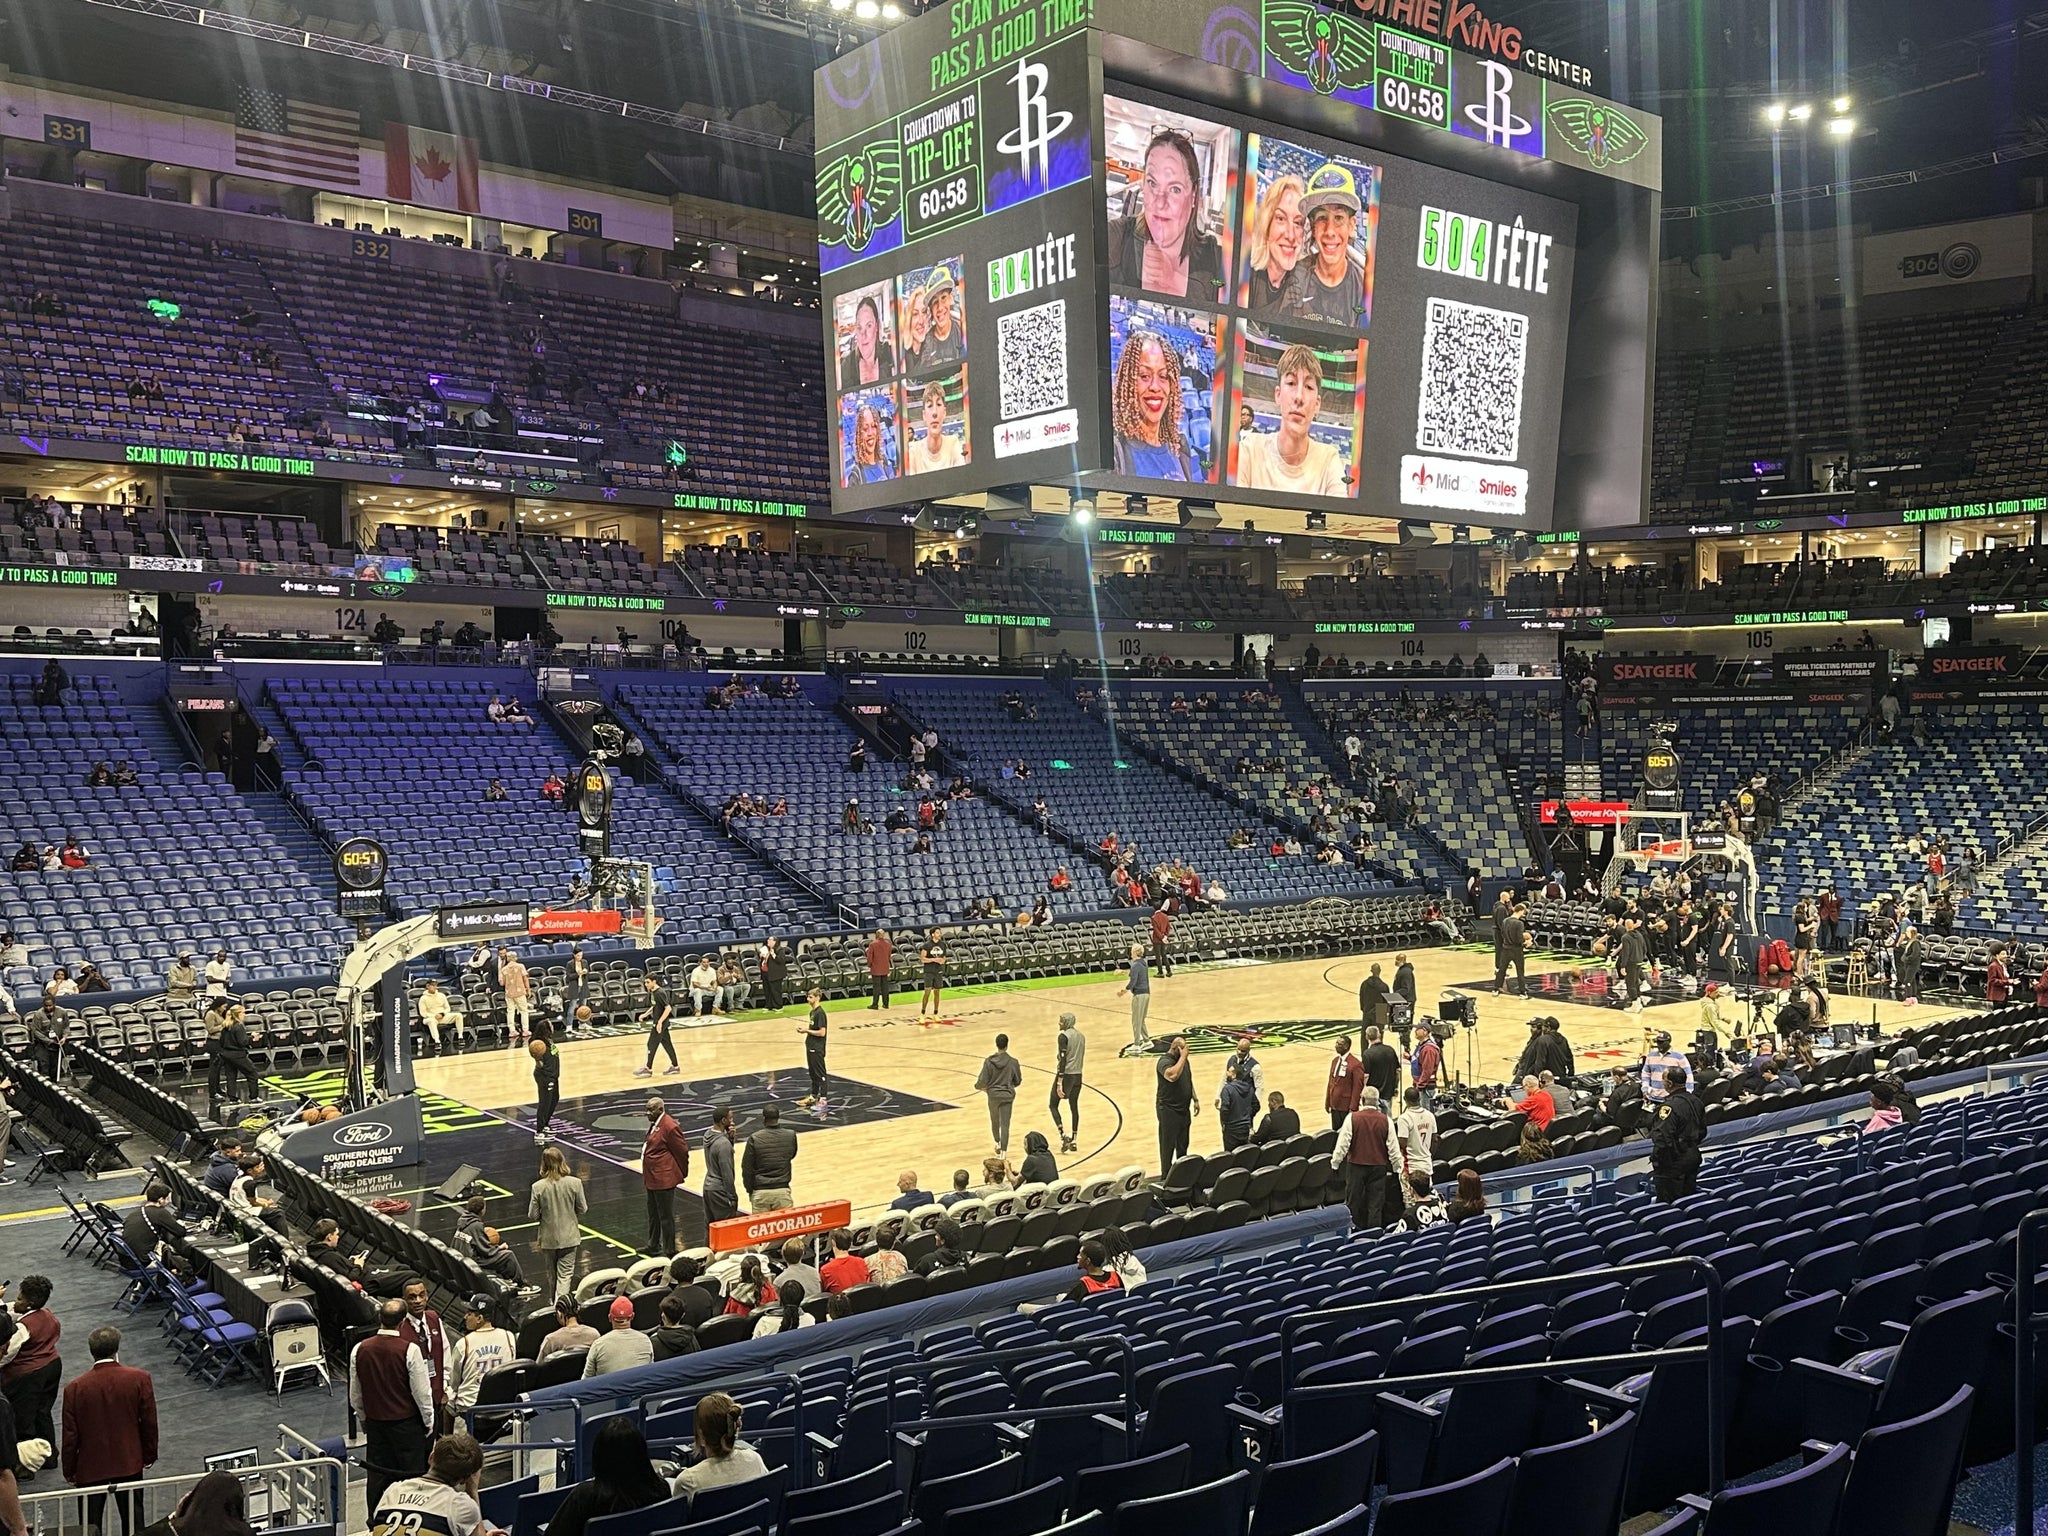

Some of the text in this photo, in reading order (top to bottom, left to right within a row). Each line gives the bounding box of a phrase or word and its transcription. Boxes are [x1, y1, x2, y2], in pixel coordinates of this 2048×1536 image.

[931, 41, 970, 91] PASS
[975, 33, 986, 70] A
[991, 8, 1036, 62] GOOD
[1381, 30, 1444, 65] COUNTDOWN TO
[1390, 50, 1435, 85] TIP-OFF
[1525, 49, 1592, 87] CENTER
[1383, 78, 1444, 121] 60:58
[904, 95, 975, 145] COUNTDOWN TO
[49, 121, 86, 143] 331
[907, 121, 974, 185] TIP-OFF
[919, 178, 967, 219] 60:58
[571, 213, 599, 232] 301
[354, 239, 390, 259] 332
[1422, 209, 1552, 295] 504 FÊTE
[990, 232, 1076, 300] 504 FÊTE
[1905, 257, 1938, 274] 306
[578, 421, 592, 430] 301
[1043, 422, 1070, 436] Smiles
[127, 446, 315, 475] SCAN NOW TO PASS A GOOD TIME!
[1480, 478, 1517, 497] Smiles
[674, 494, 807, 518] SCAN NOW TO PASS A GOOD TIME!
[1903, 497, 2047, 522] SCAN NOW TO PASS A GOOD TIME!
[1099, 529, 1175, 544] TO PASS A GOOD TIME!
[7, 568, 21, 582] TO
[23, 568, 49, 583] PASS
[51, 569, 59, 583] A
[61, 570, 88, 584] GOOD
[90, 571, 117, 586] TIME!
[546, 594, 665, 610] SCAN NOW TO PASS A GOOD TIME!
[334, 607, 367, 631] 124
[964, 613, 1051, 627] SCAN NOW TO PASS A GOOD TIME!
[1734, 610, 1849, 624] SCAN NOW TO PASS A GOOD TIME!
[1315, 623, 1415, 632] SCAN NOW TO PASS A GOOD TIME!
[904, 631, 926, 650] 102
[1118, 638, 1141, 656] 103
[1400, 639, 1425, 657] 104
[1746, 630, 1773, 648] 105
[1613, 662, 1697, 681] SEATGEEK
[1932, 655, 2007, 674] SEATGEEK
[1808, 694, 1845, 702] SEATGEEK
[343, 851, 379, 866] 60:57
[353, 889, 383, 898] TISSOT
[343, 1125, 382, 1143] Ford
[1420, 1132, 1427, 1143] 7
[323, 1146, 404, 1163] SOUTHERN QUALITY
[332, 1156, 394, 1170] FORD DEALERS
[747, 1212, 823, 1239] GATORADE
[1242, 1437, 1262, 1463] 12
[816, 1460, 825, 1478] 8
[398, 1493, 430, 1507] DAVIS
[382, 1511, 423, 1536] 23
